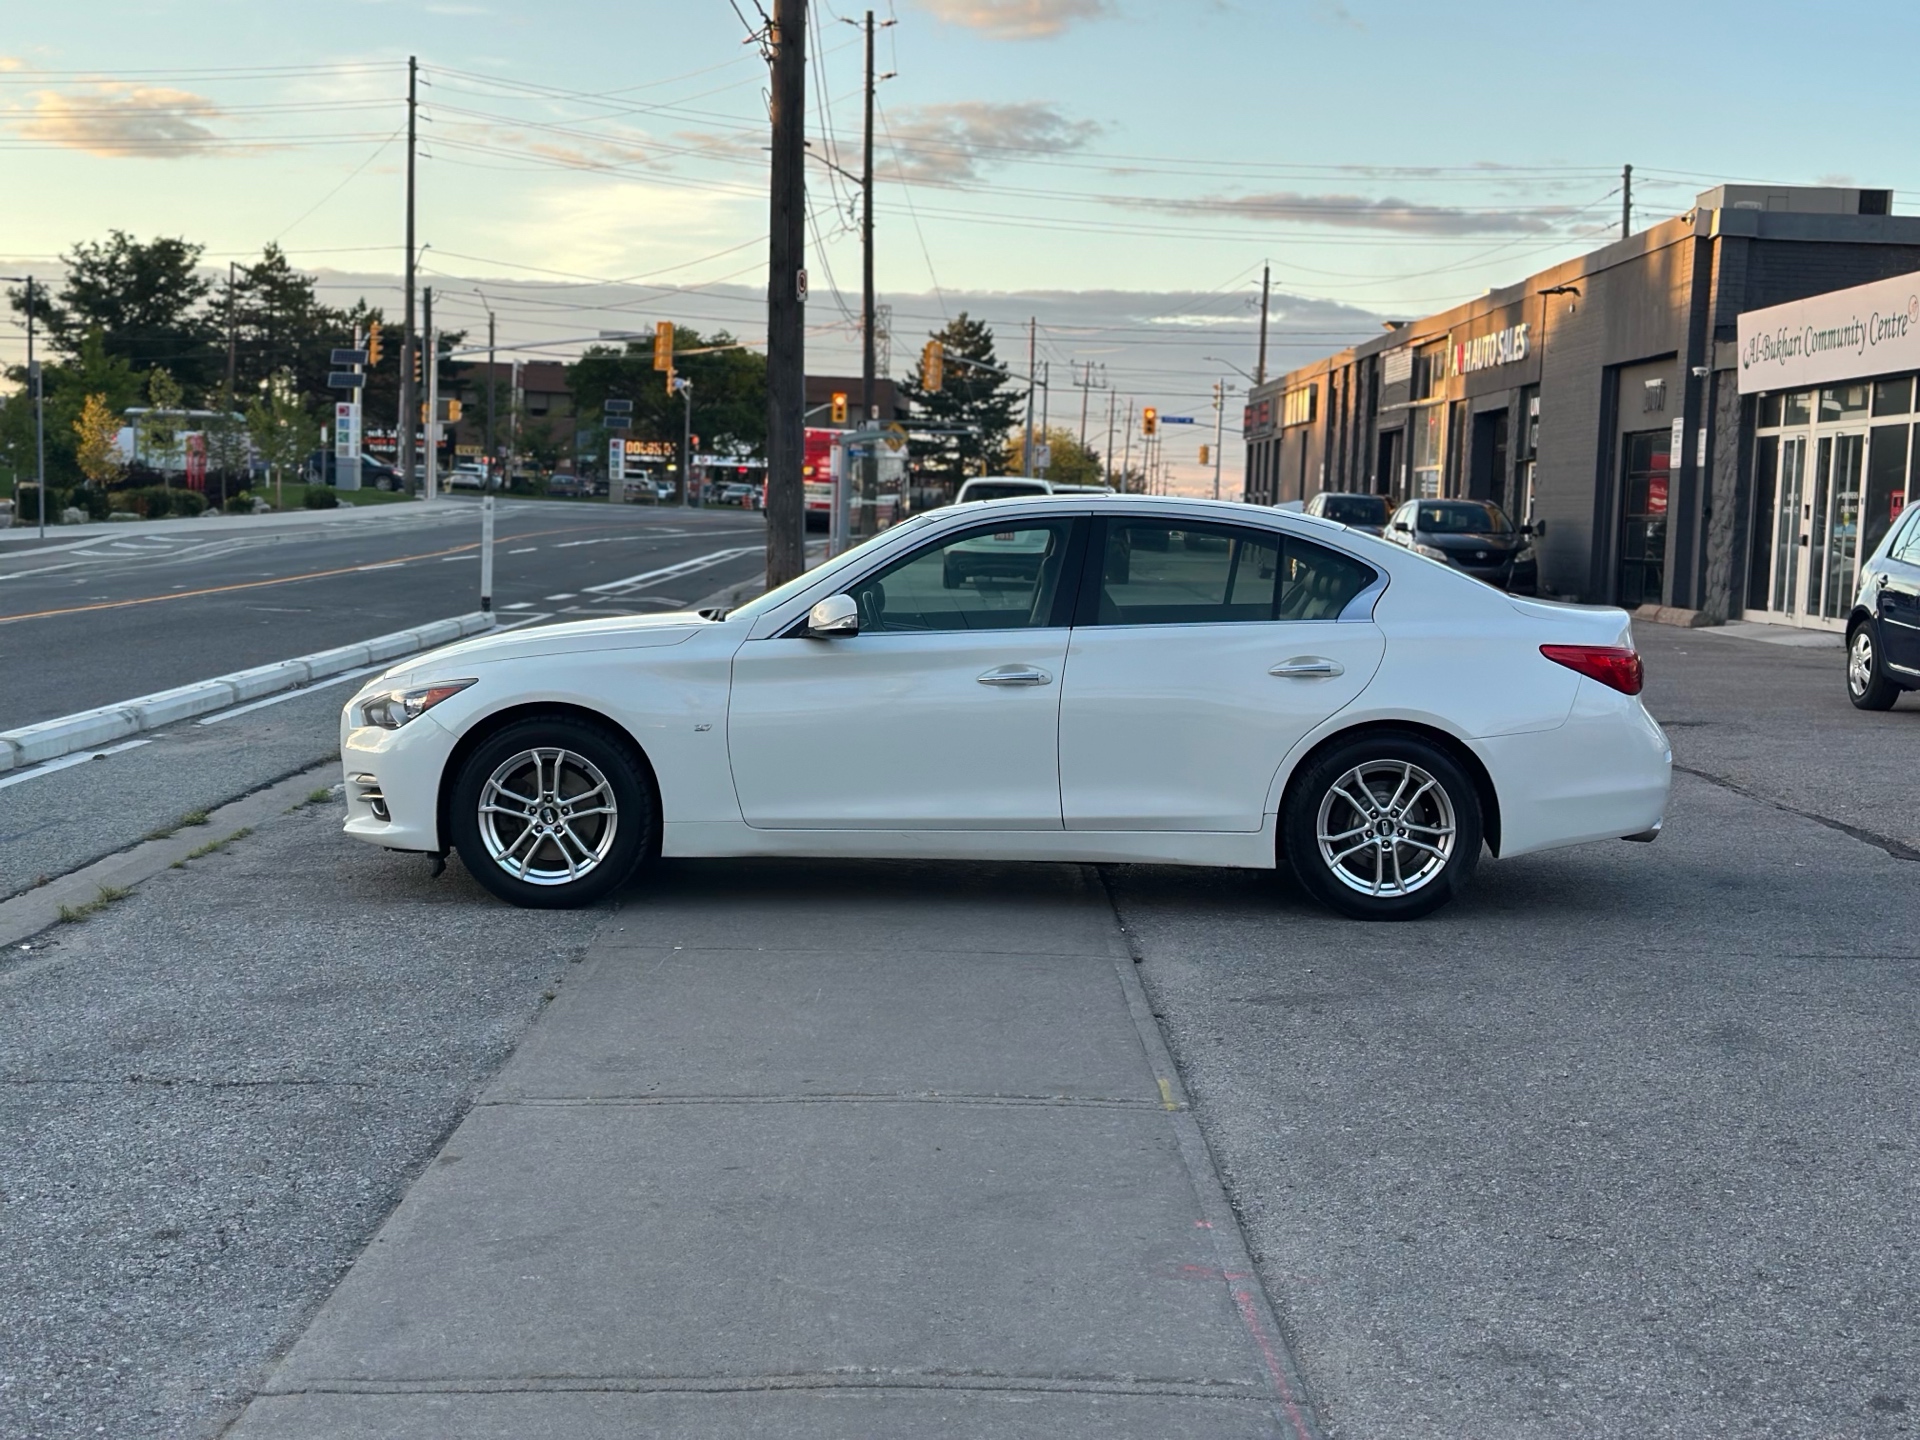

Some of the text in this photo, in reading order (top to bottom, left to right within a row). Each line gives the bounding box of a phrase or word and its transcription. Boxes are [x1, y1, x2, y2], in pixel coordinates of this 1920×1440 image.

[1470, 331, 1498, 371] AUTO
[1496, 322, 1531, 367] SALES
[1742, 311, 1909, 370] Al-Bukhari Community Centre
